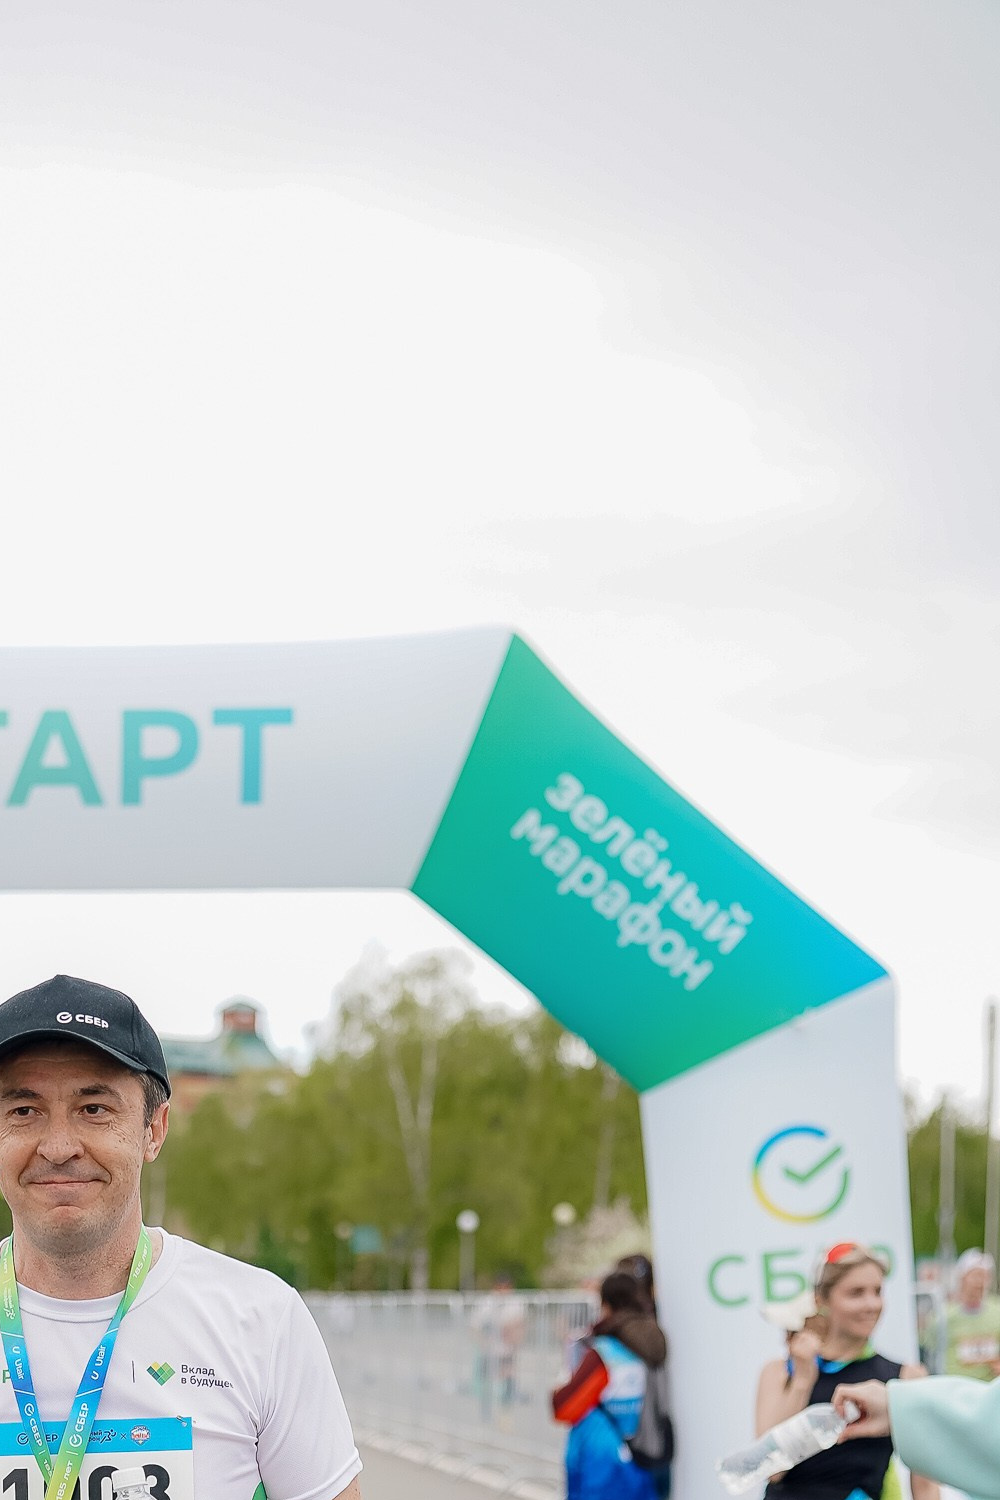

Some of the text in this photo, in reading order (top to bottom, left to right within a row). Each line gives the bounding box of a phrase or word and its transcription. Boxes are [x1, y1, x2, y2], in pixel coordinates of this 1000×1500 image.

[544, 772, 753, 955] зелёный
[510, 808, 714, 991] марафон
[75, 1013, 109, 1029] СБЕР
[707, 1243, 894, 1308] СБ
[95, 1345, 106, 1367] Utair
[14, 1359, 24, 1380] Utair
[181, 1364, 215, 1376] Вклад
[181, 1376, 187, 1385] в
[29, 1417, 42, 1447] СБЕР
[56, 1402, 90, 1500] СБЕР 185 лет
